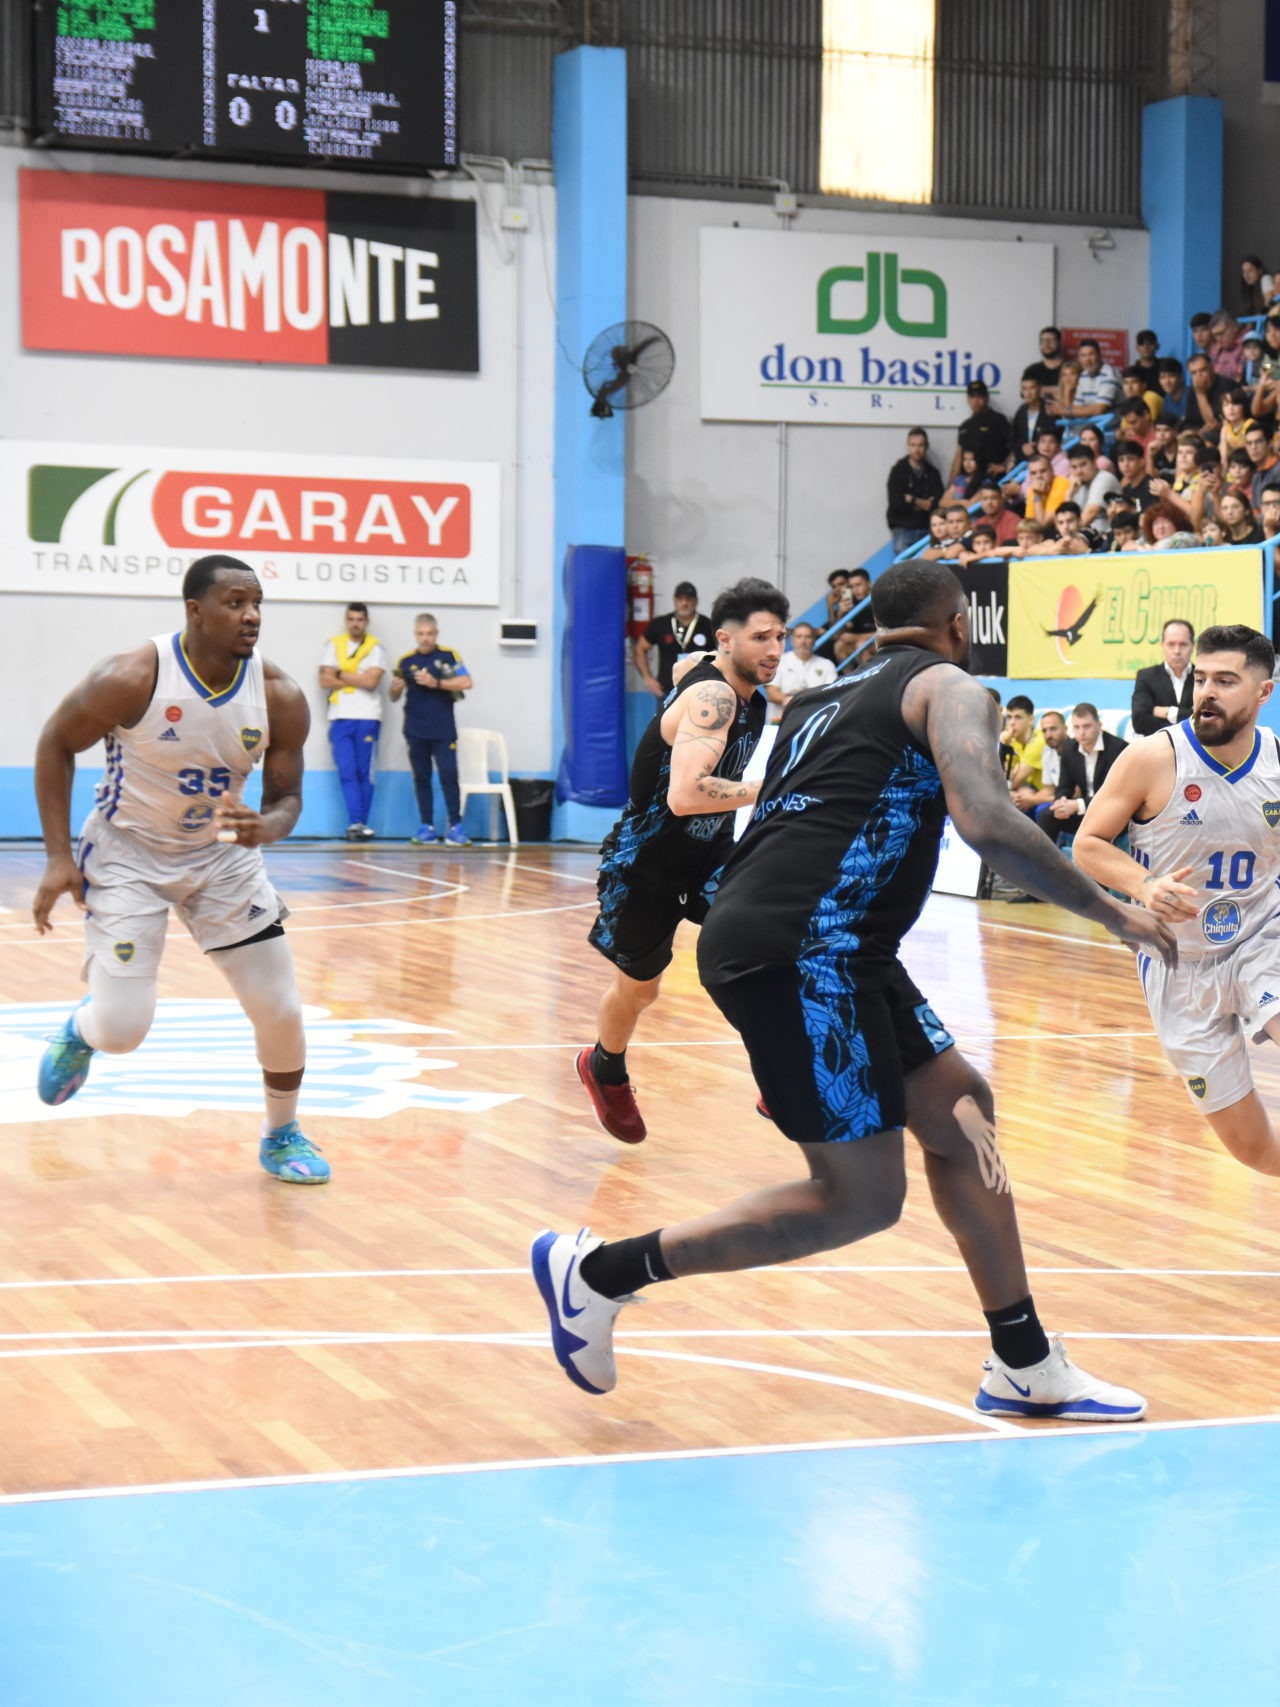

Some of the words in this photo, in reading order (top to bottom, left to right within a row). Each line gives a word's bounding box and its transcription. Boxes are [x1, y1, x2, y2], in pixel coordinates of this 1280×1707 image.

[253, 8, 271, 33] 1
[229, 96, 251, 127] 0
[275, 100, 297, 130] 0
[61, 219, 439, 333] ROSAMONTE
[760, 343, 844, 382] don
[860, 346, 1001, 388] basilio
[181, 485, 459, 545] GARAY
[32, 551, 195, 577] TRANSPO
[261, 561, 279, 579] &
[296, 562, 469, 585] LOGISTICA
[968, 591, 1005, 645] luk
[1102, 586, 1125, 644] EL
[178, 767, 231, 797] 35
[1205, 850, 1257, 890] 10
[1204, 922, 1240, 937] Chiquita
